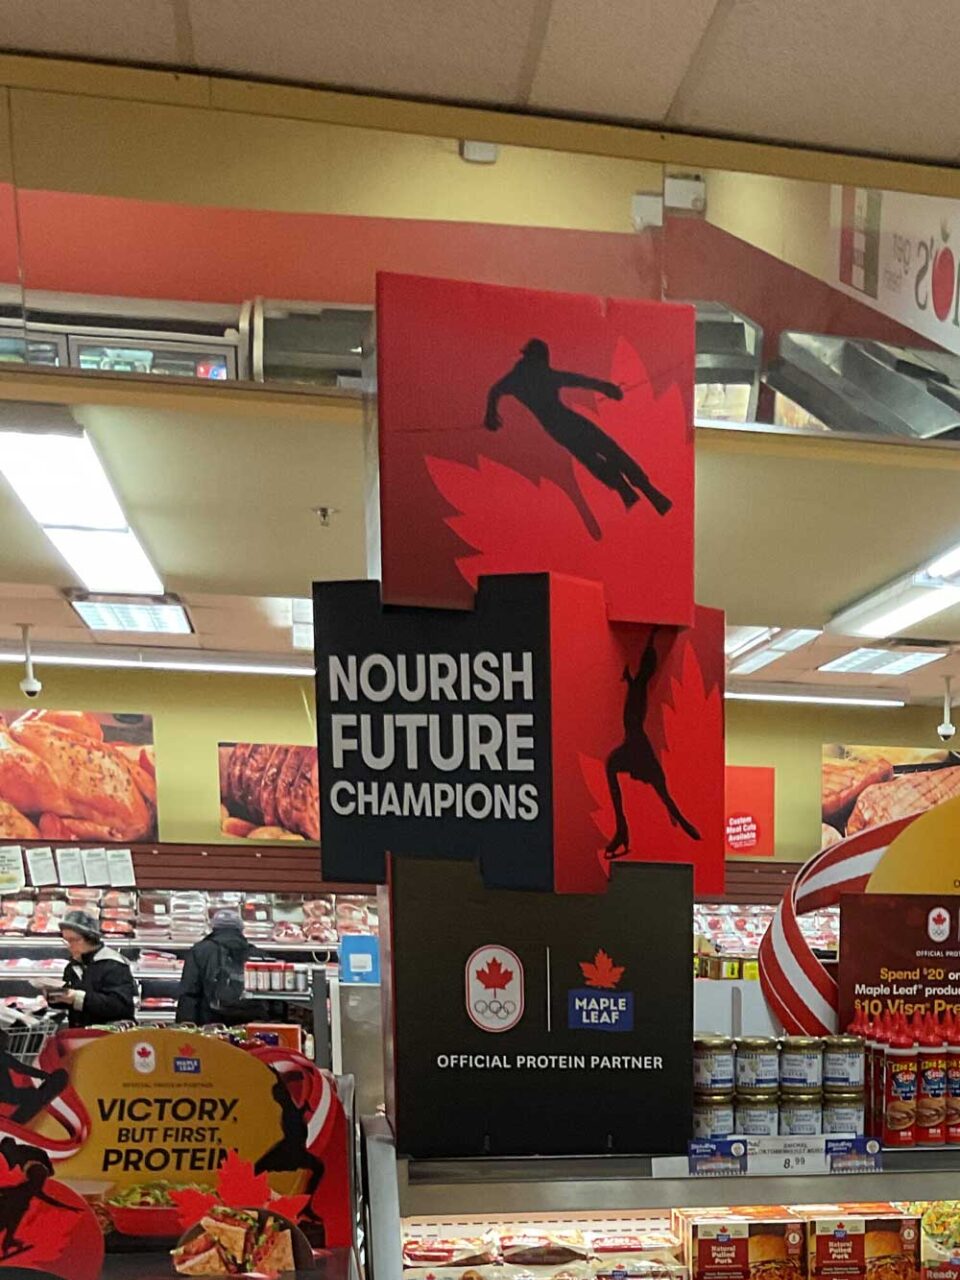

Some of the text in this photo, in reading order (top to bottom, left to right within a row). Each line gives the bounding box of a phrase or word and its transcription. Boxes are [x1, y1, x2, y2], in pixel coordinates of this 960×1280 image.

[329, 651, 533, 702] NOURISH
[331, 714, 534, 771] FUTURE
[330, 780, 539, 820] CHAMPIONS
[915, 950, 944, 958] OFFICIAL
[880, 968, 920, 982] Spend
[854, 984, 891, 997] Maple
[575, 998, 626, 1011] MAPLE
[582, 1011, 619, 1024] LEAF
[437, 1055, 663, 1069] OFFICIAL PROTEIN PARTNER
[97, 1098, 239, 1123] VICTORY,
[117, 1127, 222, 1144] BUT FIRST,
[783, 1157, 806, 1169] 8.99
[927, 1269, 959, 1280] Ready
